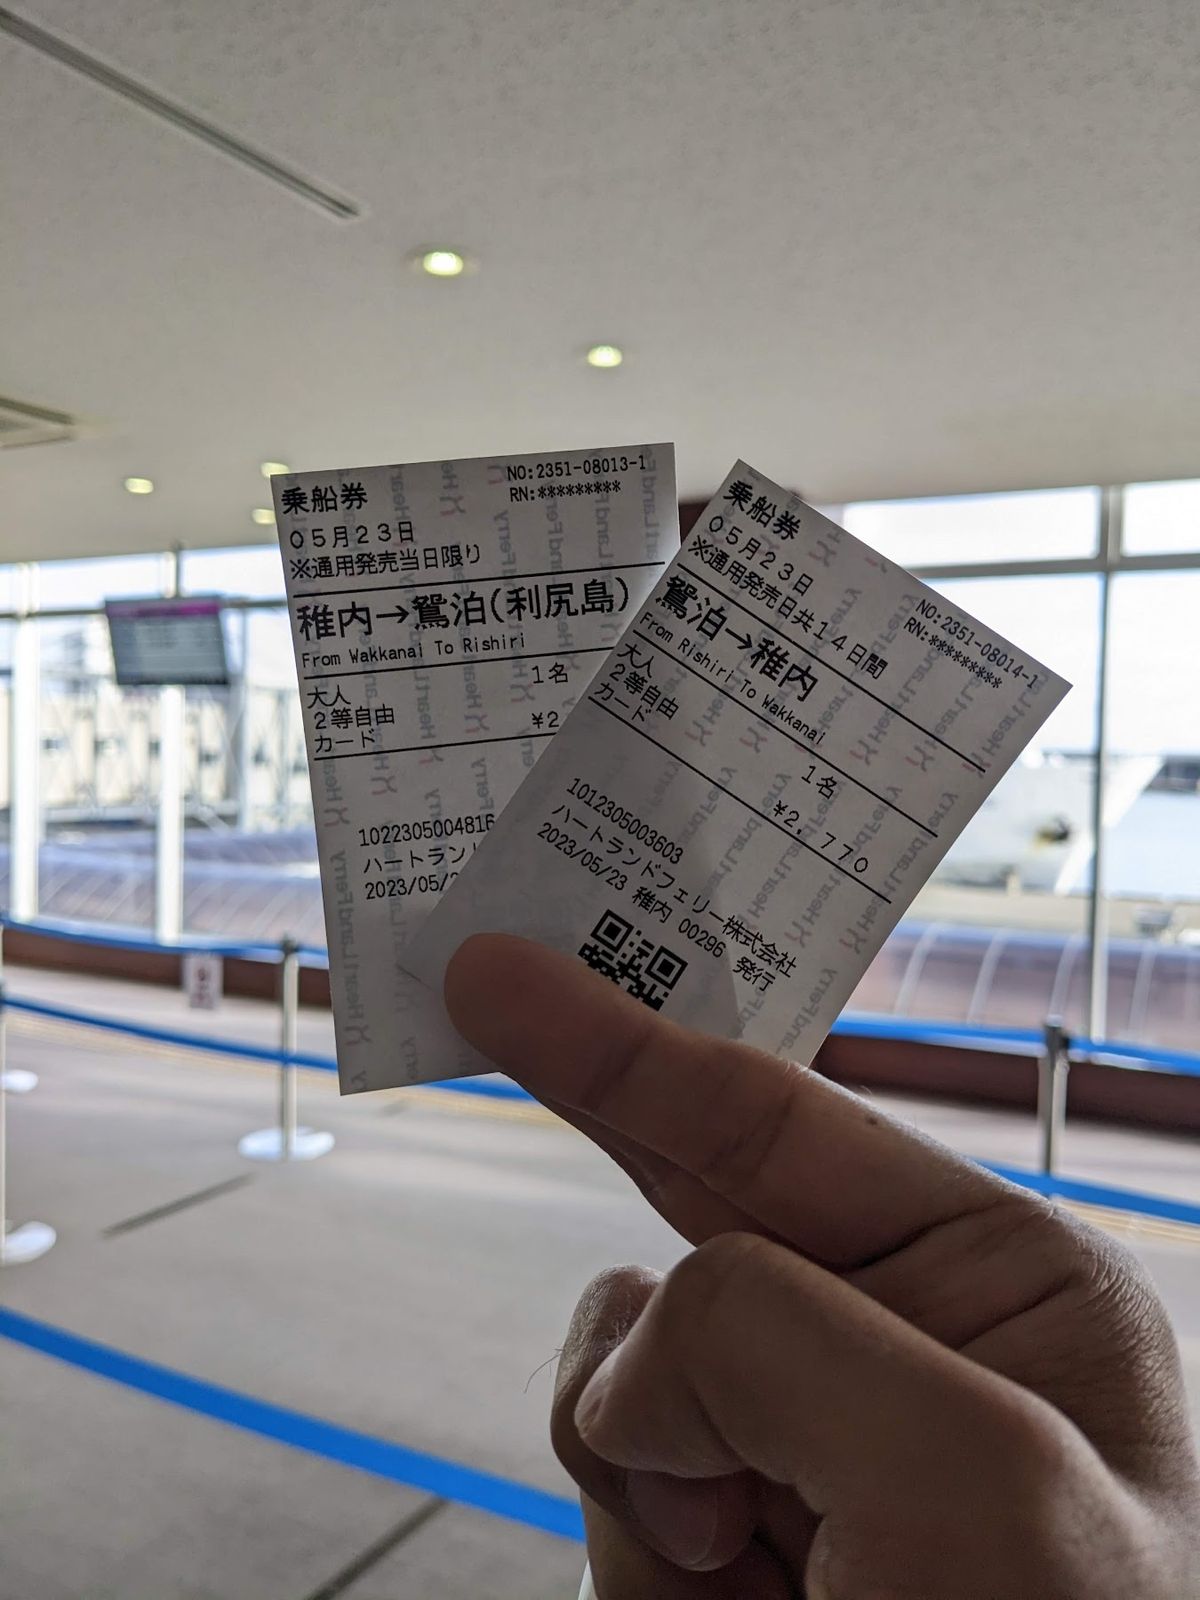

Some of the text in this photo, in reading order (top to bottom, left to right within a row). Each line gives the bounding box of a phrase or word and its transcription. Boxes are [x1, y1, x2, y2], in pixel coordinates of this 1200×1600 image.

[507, 455, 646, 481] NO:2351-08013-1
[281, 482, 368, 515] 乗船券
[723, 480, 801, 540] 乗船券
[301, 632, 525, 668] From Wakkanai To Rishiri
[616, 643, 655, 679] 大人
[915, 599, 1038, 689] NO:2351-08014-1
[531, 661, 569, 684] 1名
[639, 611, 826, 745] From Rishiri To Wakkanai
[306, 684, 352, 710] 大人
[593, 682, 652, 722] カード
[609, 663, 679, 720] 2等自由
[314, 703, 395, 730] 2等自由
[314, 728, 376, 754] カード
[801, 765, 838, 800] 1名
[566, 778, 684, 865] 1012305003603
[363, 842, 476, 874] ハートラン
[364, 871, 458, 900] 2023/05/
[552, 805, 796, 978] ハートランドフェリー株式会社
[537, 822, 776, 992] 2023/05/23 稚内 00296 発行
